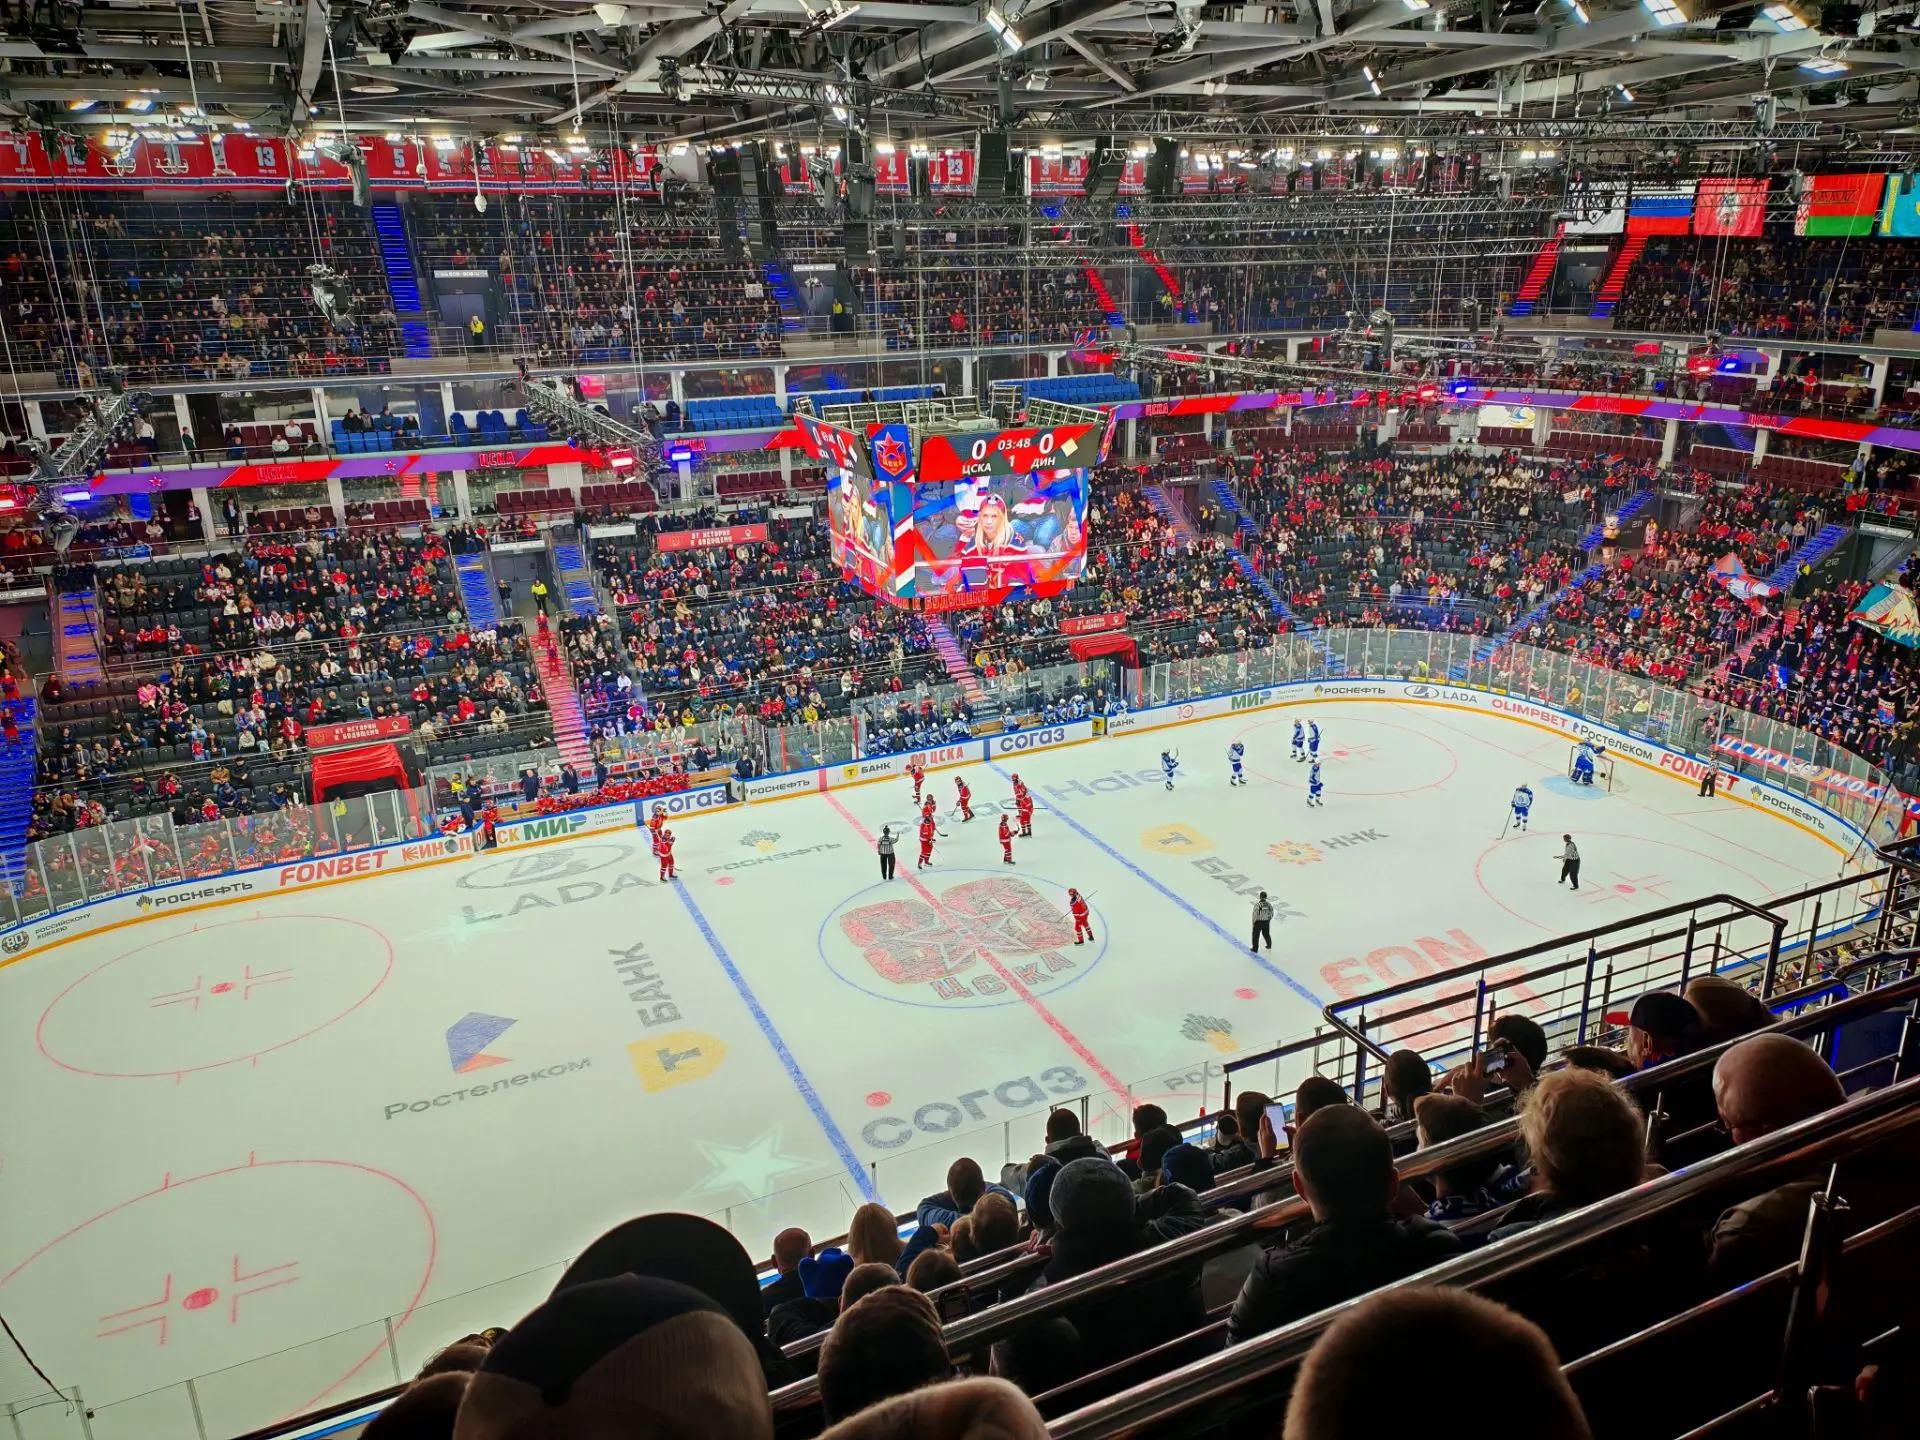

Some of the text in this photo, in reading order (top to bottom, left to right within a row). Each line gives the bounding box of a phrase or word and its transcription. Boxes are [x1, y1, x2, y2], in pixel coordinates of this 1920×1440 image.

[255, 146, 276, 168] 13
[393, 148, 406, 168] 5
[635, 154, 645, 173] 9
[947, 158, 964, 176] 23
[971, 433, 1054, 460] 0 03:48 0
[479, 450, 515, 467] ЦСКА
[962, 455, 1056, 475] ЦСКА 1 ДИН
[256, 464, 297, 482] ЦСКА
[702, 529, 731, 539] ИСТОРИИ
[1825, 557, 1840, 567] 212
[924, 590, 989, 611] БУДУЩЕМУ
[1231, 690, 1272, 711] МИР
[1324, 687, 1386, 695] РОСНЕФТЬ
[1442, 690, 1478, 704] LADA
[1109, 718, 1135, 729] БАНК
[1491, 698, 1569, 729] OLIMPBET
[347, 722, 377, 733] ИСТОРИИ
[1580, 723, 1652, 760] Ростелеком
[930, 746, 964, 764] ЦСКА
[861, 761, 891, 774] БАНК
[750, 779, 810, 796] РОСНЕФТЬ
[1762, 793, 1825, 831] РОСНЕФТЬ
[523, 814, 587, 841] МИР
[1319, 827, 1389, 850] ННК
[280, 850, 390, 887] FONBET
[706, 842, 843, 875] РОСНЕФТЬ
[155, 881, 253, 907] РОСНЕФТЬ
[460, 871, 657, 925] LADA
[35, 912, 91, 934] РОССИЙСКОМУ
[6, 933, 24, 948] 80
[607, 941, 682, 1029] БАНК
[930, 950, 1078, 1001] ЦСКА
[384, 1056, 592, 1120] Ростелеком
